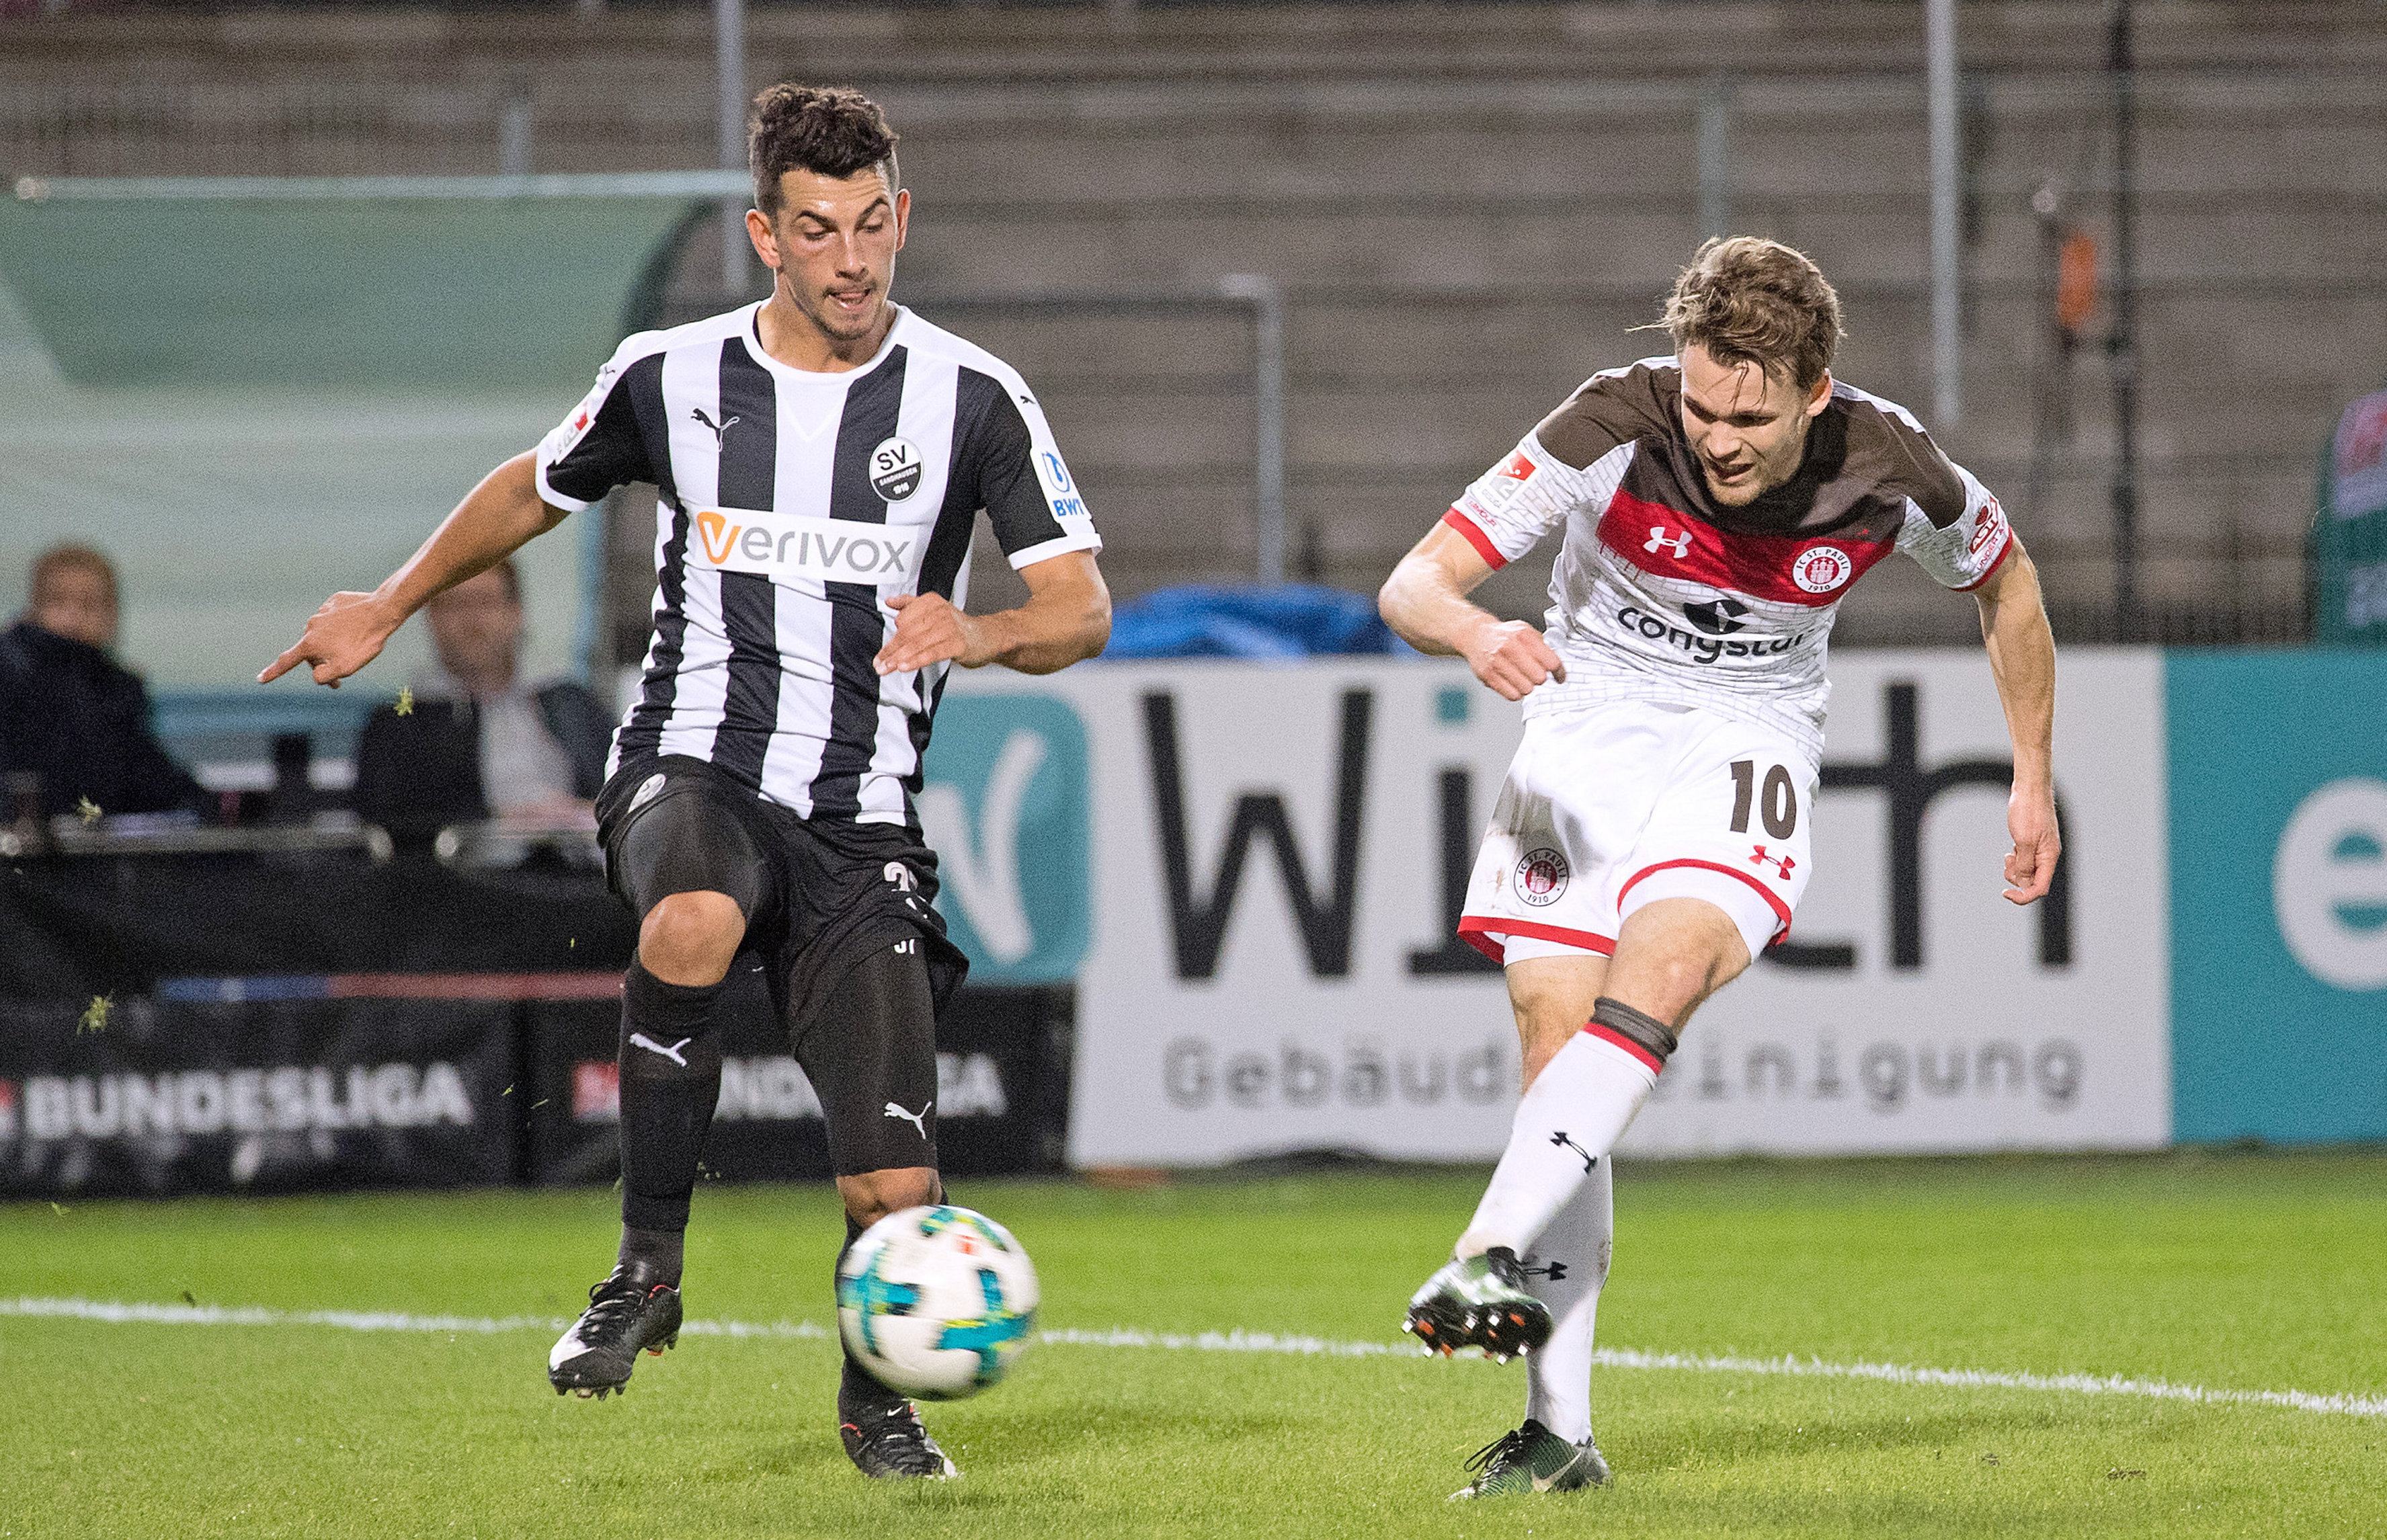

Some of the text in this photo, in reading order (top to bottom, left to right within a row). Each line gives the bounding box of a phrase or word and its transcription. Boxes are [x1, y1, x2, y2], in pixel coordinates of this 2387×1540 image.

[877, 444, 905, 471] SV
[1796, 559, 1806, 569] FC
[1730, 760, 1797, 840] 10
[1518, 862, 1528, 875] FC
[1527, 894, 1549, 903] 1910
[24, 1062, 473, 1139] BUNDESLIGA
